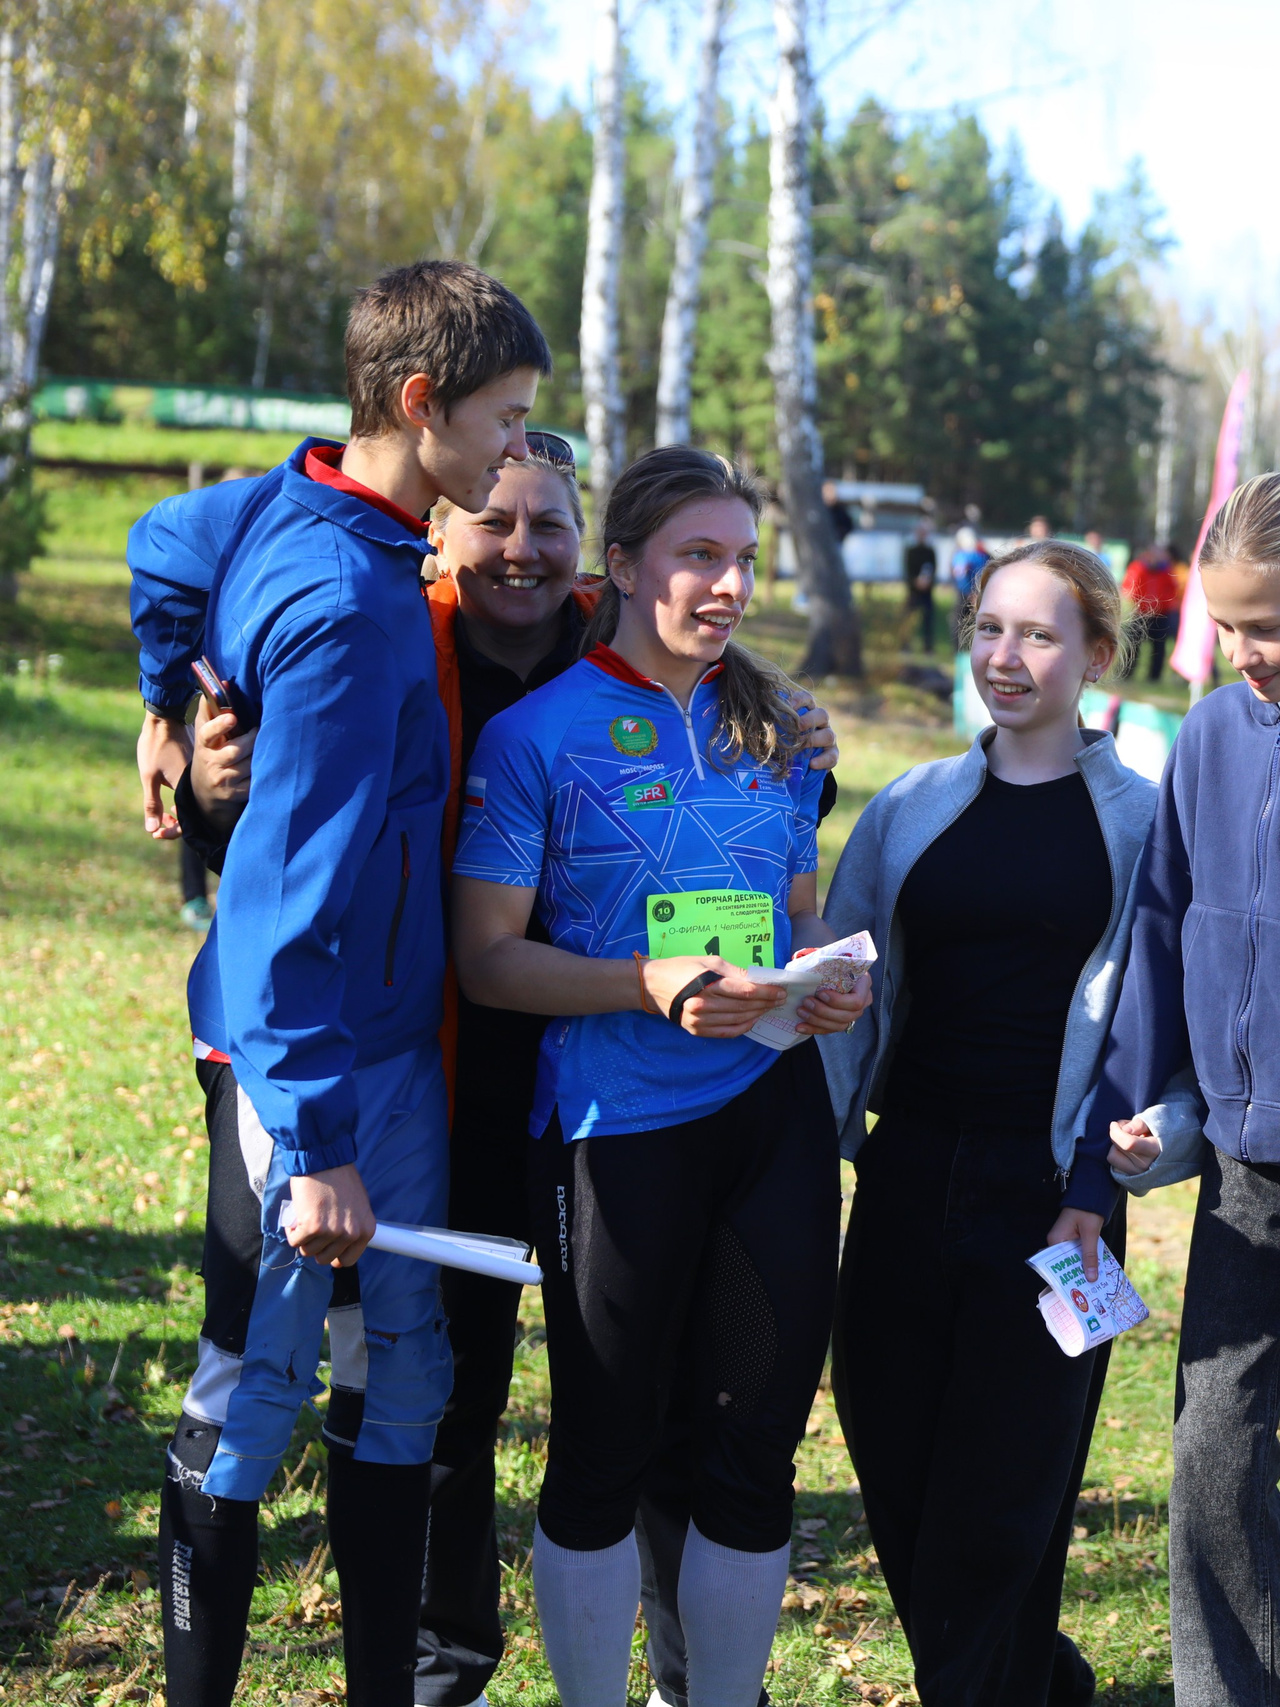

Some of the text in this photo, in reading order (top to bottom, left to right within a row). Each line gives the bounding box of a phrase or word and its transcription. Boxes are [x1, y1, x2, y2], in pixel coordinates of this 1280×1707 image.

[634, 786, 663, 801] SFR
[695, 893, 769, 904] ГОРЯЧАЯ ДЕСЯТКА
[657, 907, 671, 915] 10
[668, 924, 711, 934] О-ФИРМА
[720, 921, 760, 931] Челябинск
[744, 933, 771, 943] ЭТАП
[752, 945, 763, 967] 5
[557, 1185, 568, 1272] noname
[172, 1539, 193, 1632] noname
